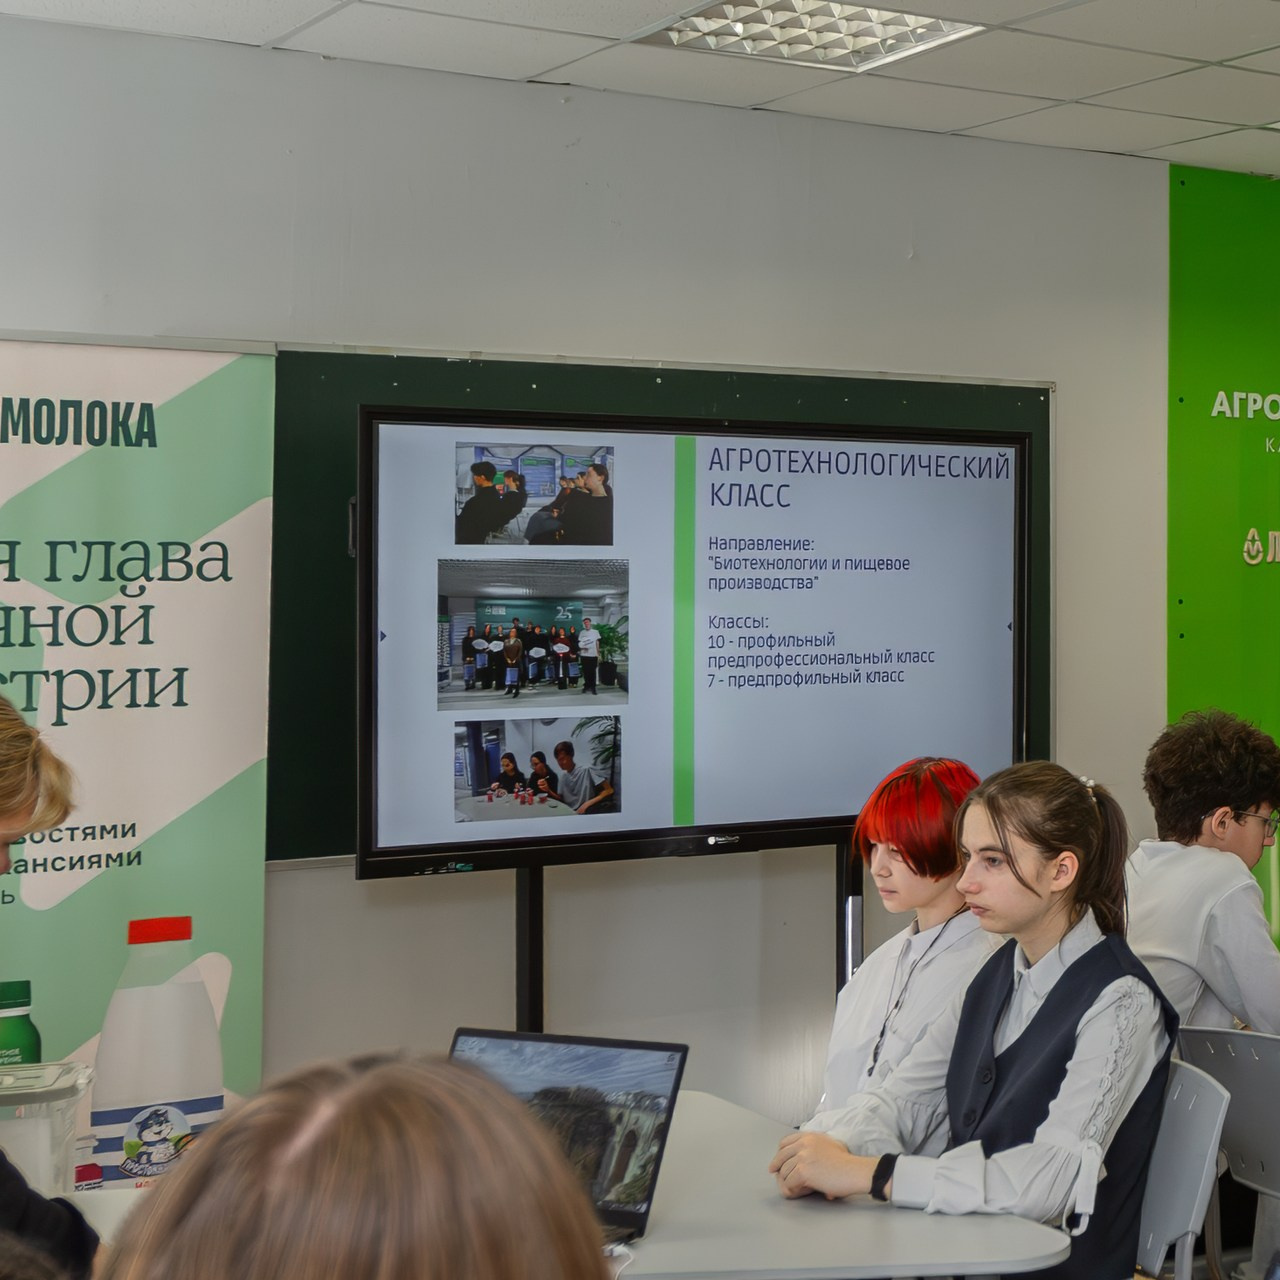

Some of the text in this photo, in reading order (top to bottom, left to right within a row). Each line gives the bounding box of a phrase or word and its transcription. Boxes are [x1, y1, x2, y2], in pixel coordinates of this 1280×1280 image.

[0, 397, 158, 448] МОЛОКА
[708, 446, 1011, 480] АГРОТЕХНОЛОГИЧЕСКИЙ
[710, 482, 792, 508] КЛАСС
[708, 536, 815, 553] Направление:
[43, 539, 233, 584] глава
[708, 556, 910, 573] "Биотехнологии и пищевое
[708, 575, 819, 592] производства"
[708, 615, 769, 629] Классы:
[708, 634, 725, 649] 10
[738, 632, 836, 650] профильный
[708, 650, 935, 670] предпрофессиональный класс
[708, 673, 716, 688] 7
[728, 669, 862, 689] предпрофильный
[865, 670, 905, 684] класс
[5, 850, 143, 875] ансиями
